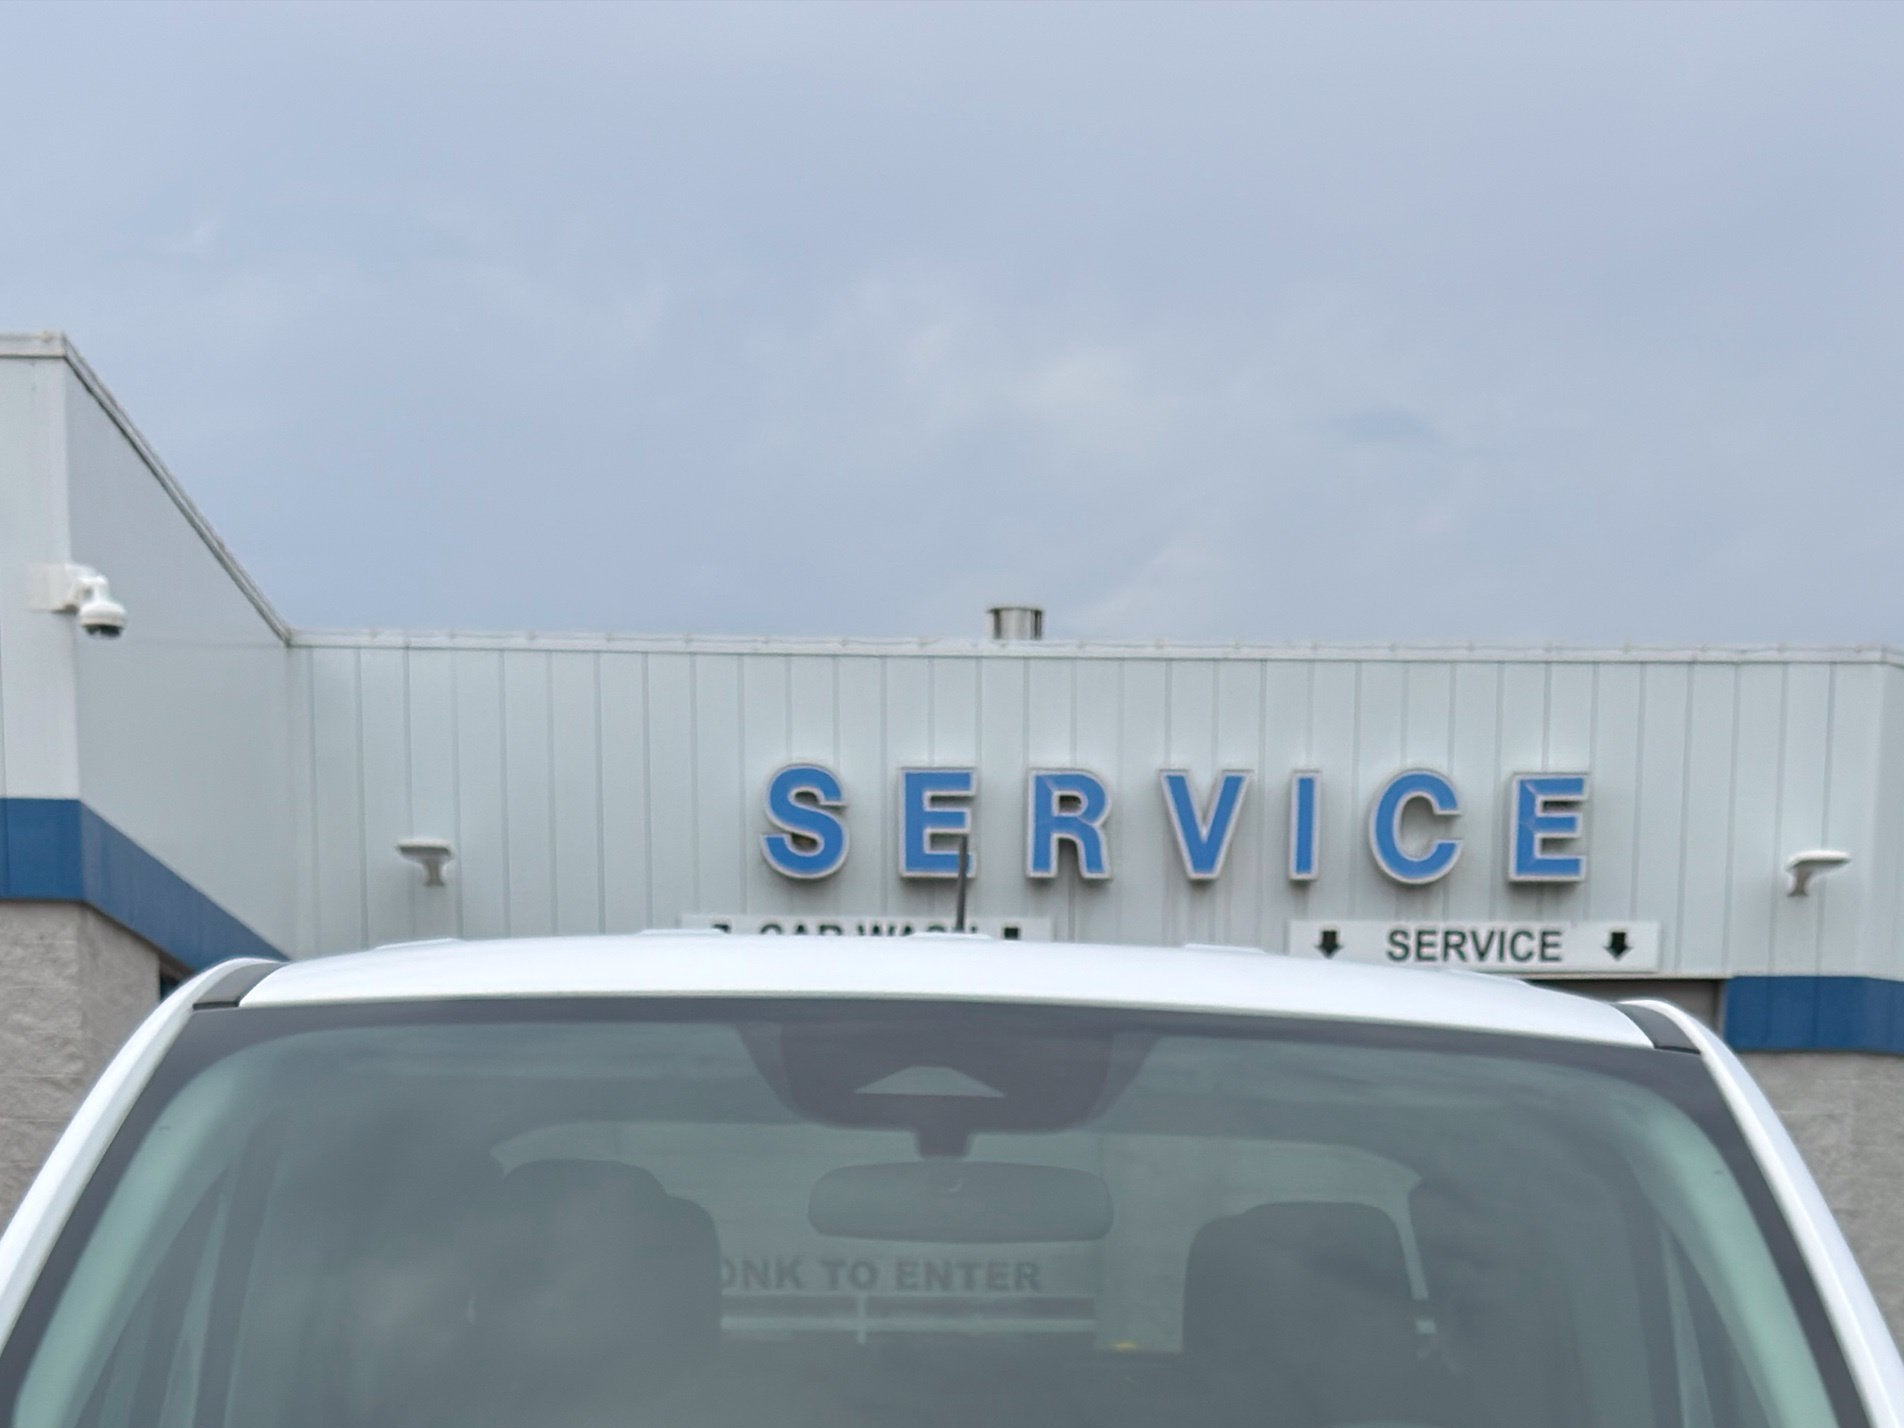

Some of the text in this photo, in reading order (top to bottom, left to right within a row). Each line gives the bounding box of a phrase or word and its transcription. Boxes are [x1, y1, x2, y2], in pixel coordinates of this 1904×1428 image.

[761, 763, 1593, 883] SERVICE
[1386, 929, 1563, 963] SERVICE
[721, 1258, 1042, 1292] ONK TO ENTER
